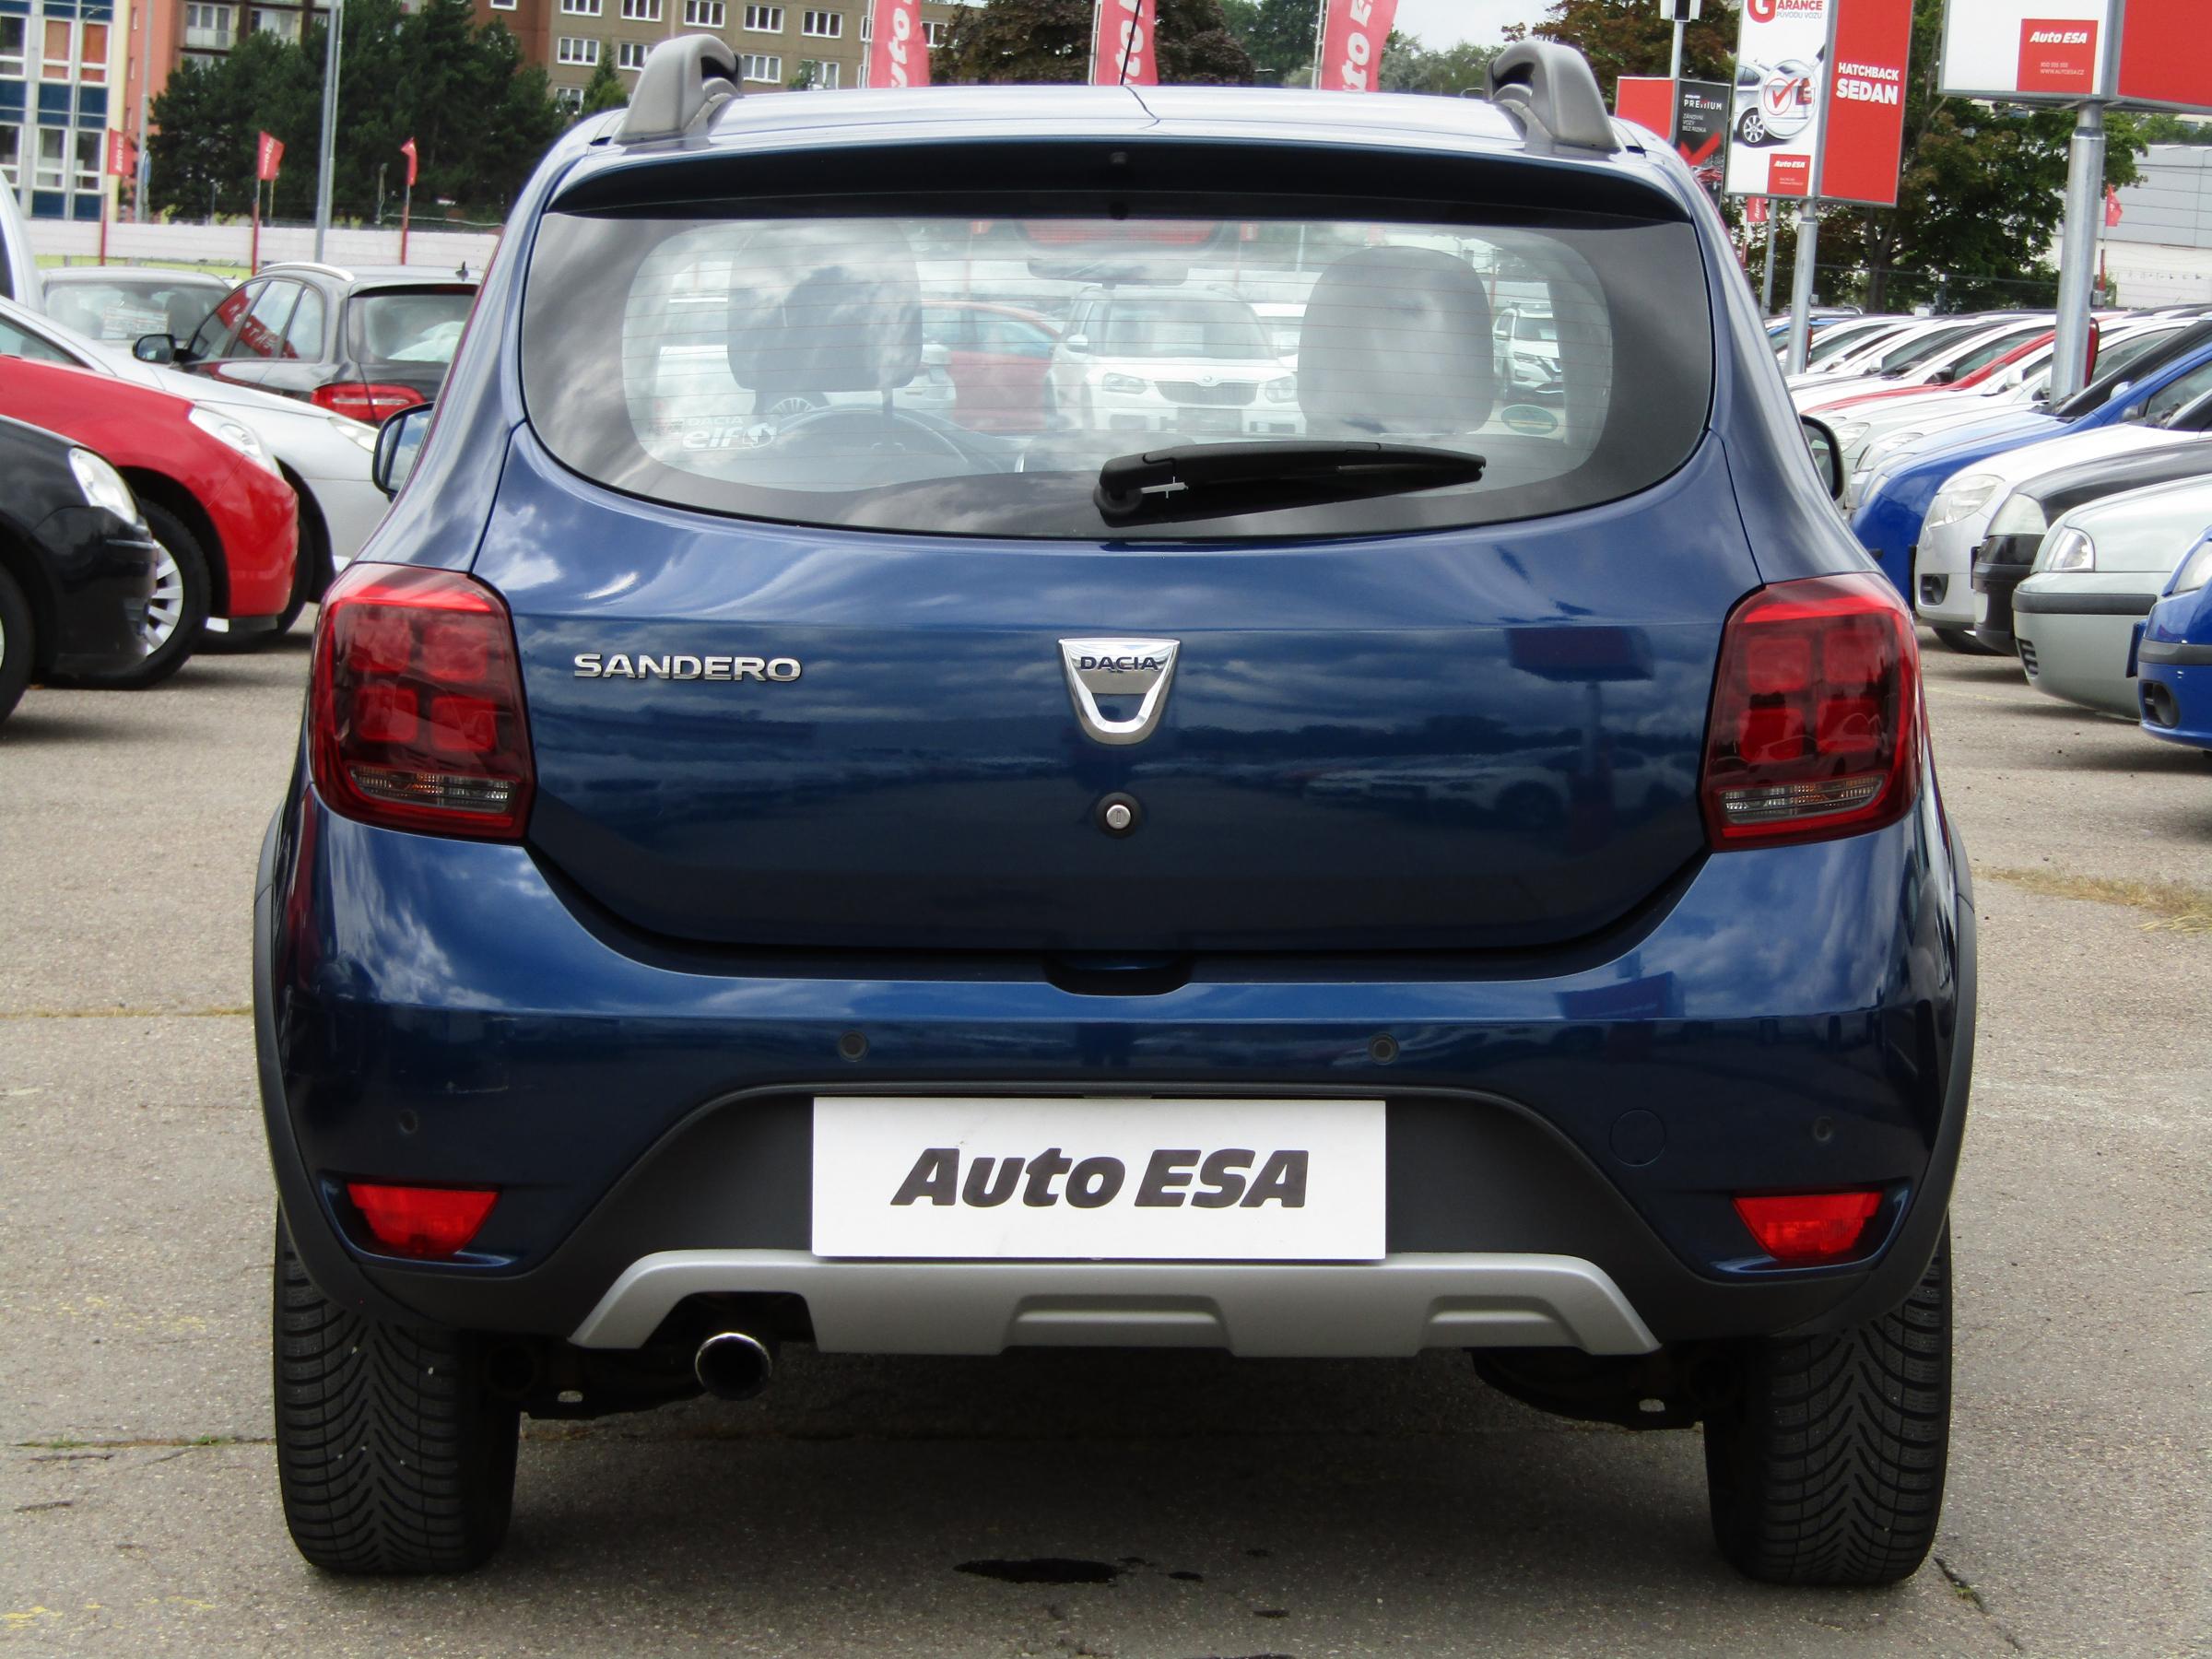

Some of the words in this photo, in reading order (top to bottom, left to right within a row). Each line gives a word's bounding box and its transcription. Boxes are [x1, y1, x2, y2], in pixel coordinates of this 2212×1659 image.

[2030, 31, 2062, 43] Auto
[2062, 32, 2088, 43] ESA
[1838, 62, 1900, 81] HATCHBACK
[1836, 77, 1899, 105] SEDAN
[688, 417, 744, 427] DACIA
[683, 428, 742, 449] elf
[574, 653, 801, 682] SANDERO
[1080, 656, 1158, 670] DACIA
[890, 1147, 1126, 1208] Auto
[1134, 1148, 1309, 1208] ESA
